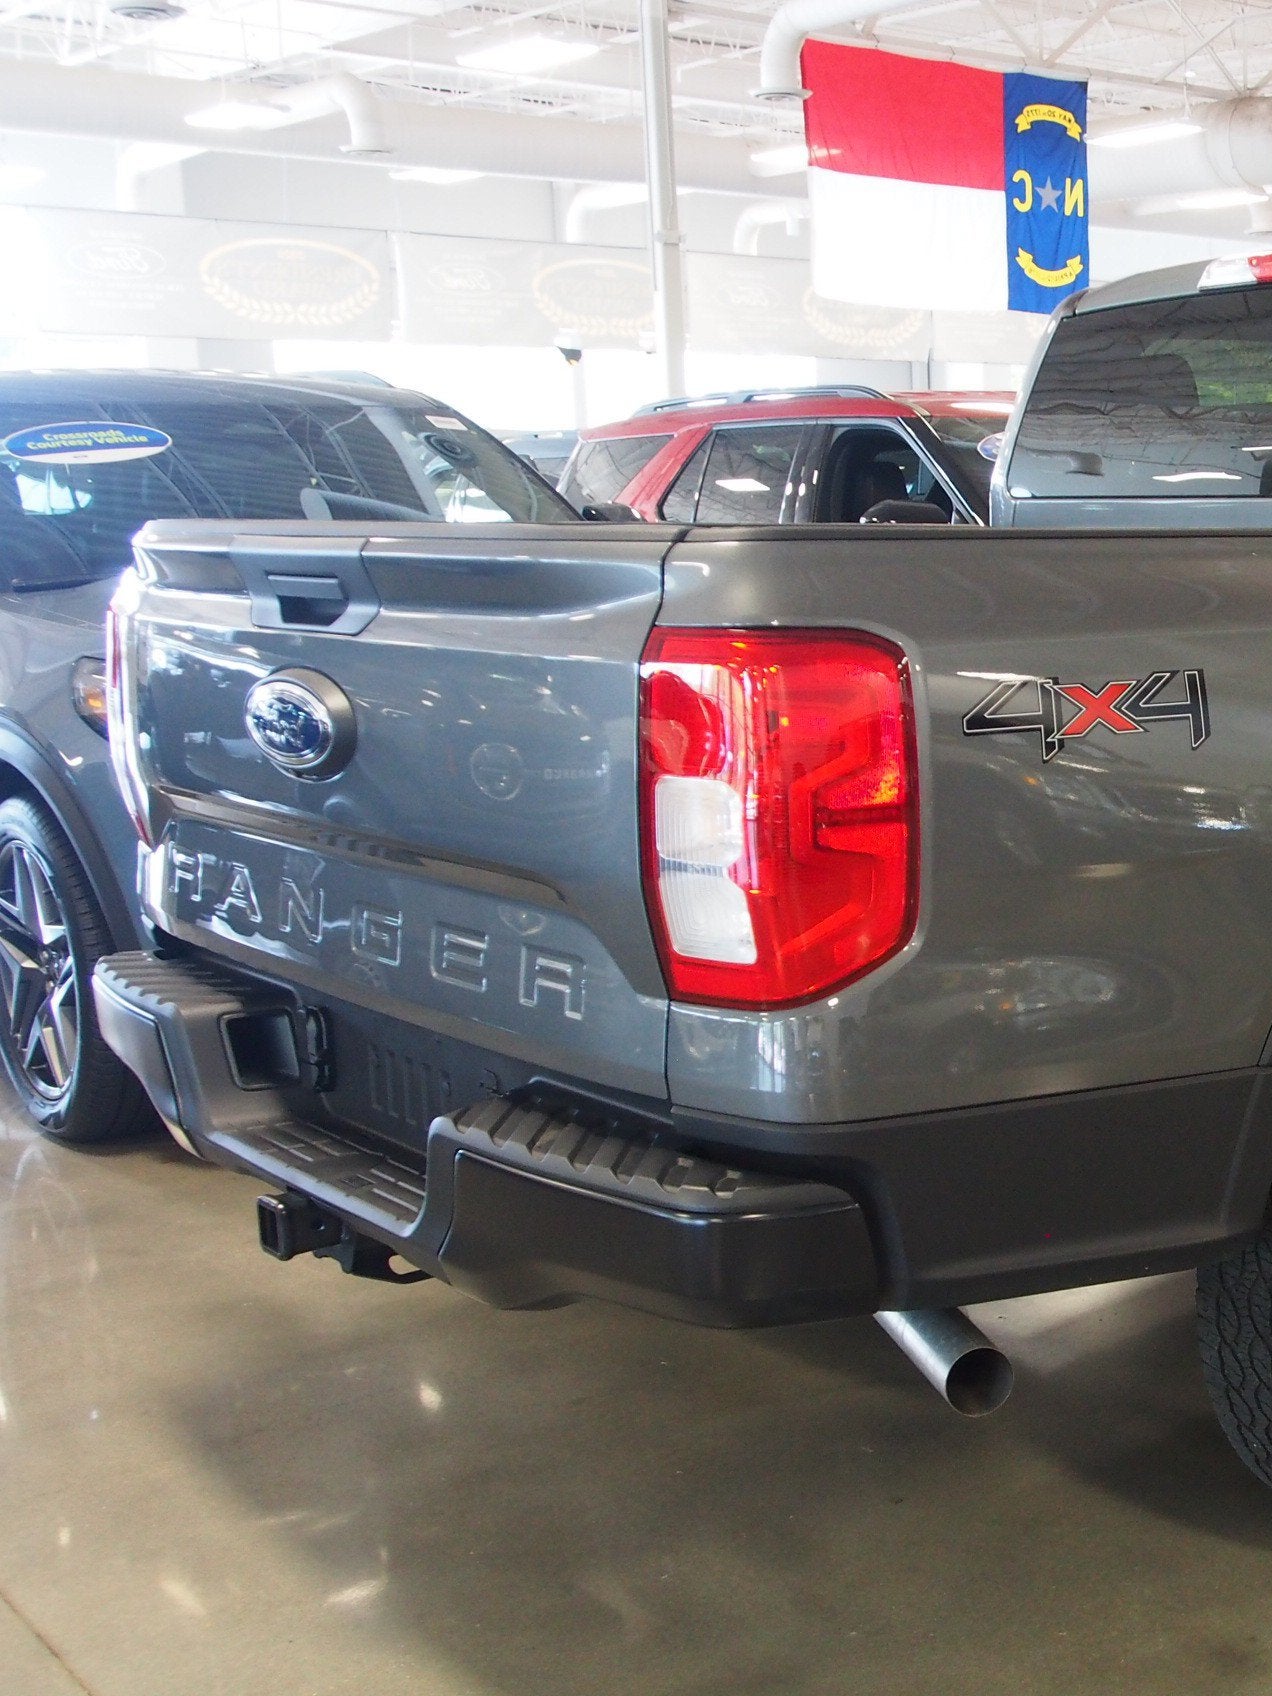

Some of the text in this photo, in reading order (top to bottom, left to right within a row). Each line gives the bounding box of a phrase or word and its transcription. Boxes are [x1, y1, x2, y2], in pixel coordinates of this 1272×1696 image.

[26, 435, 149, 450] Courtesy Vehicle
[42, 429, 125, 441] Crossroads
[168, 840, 588, 1021] RANGER
